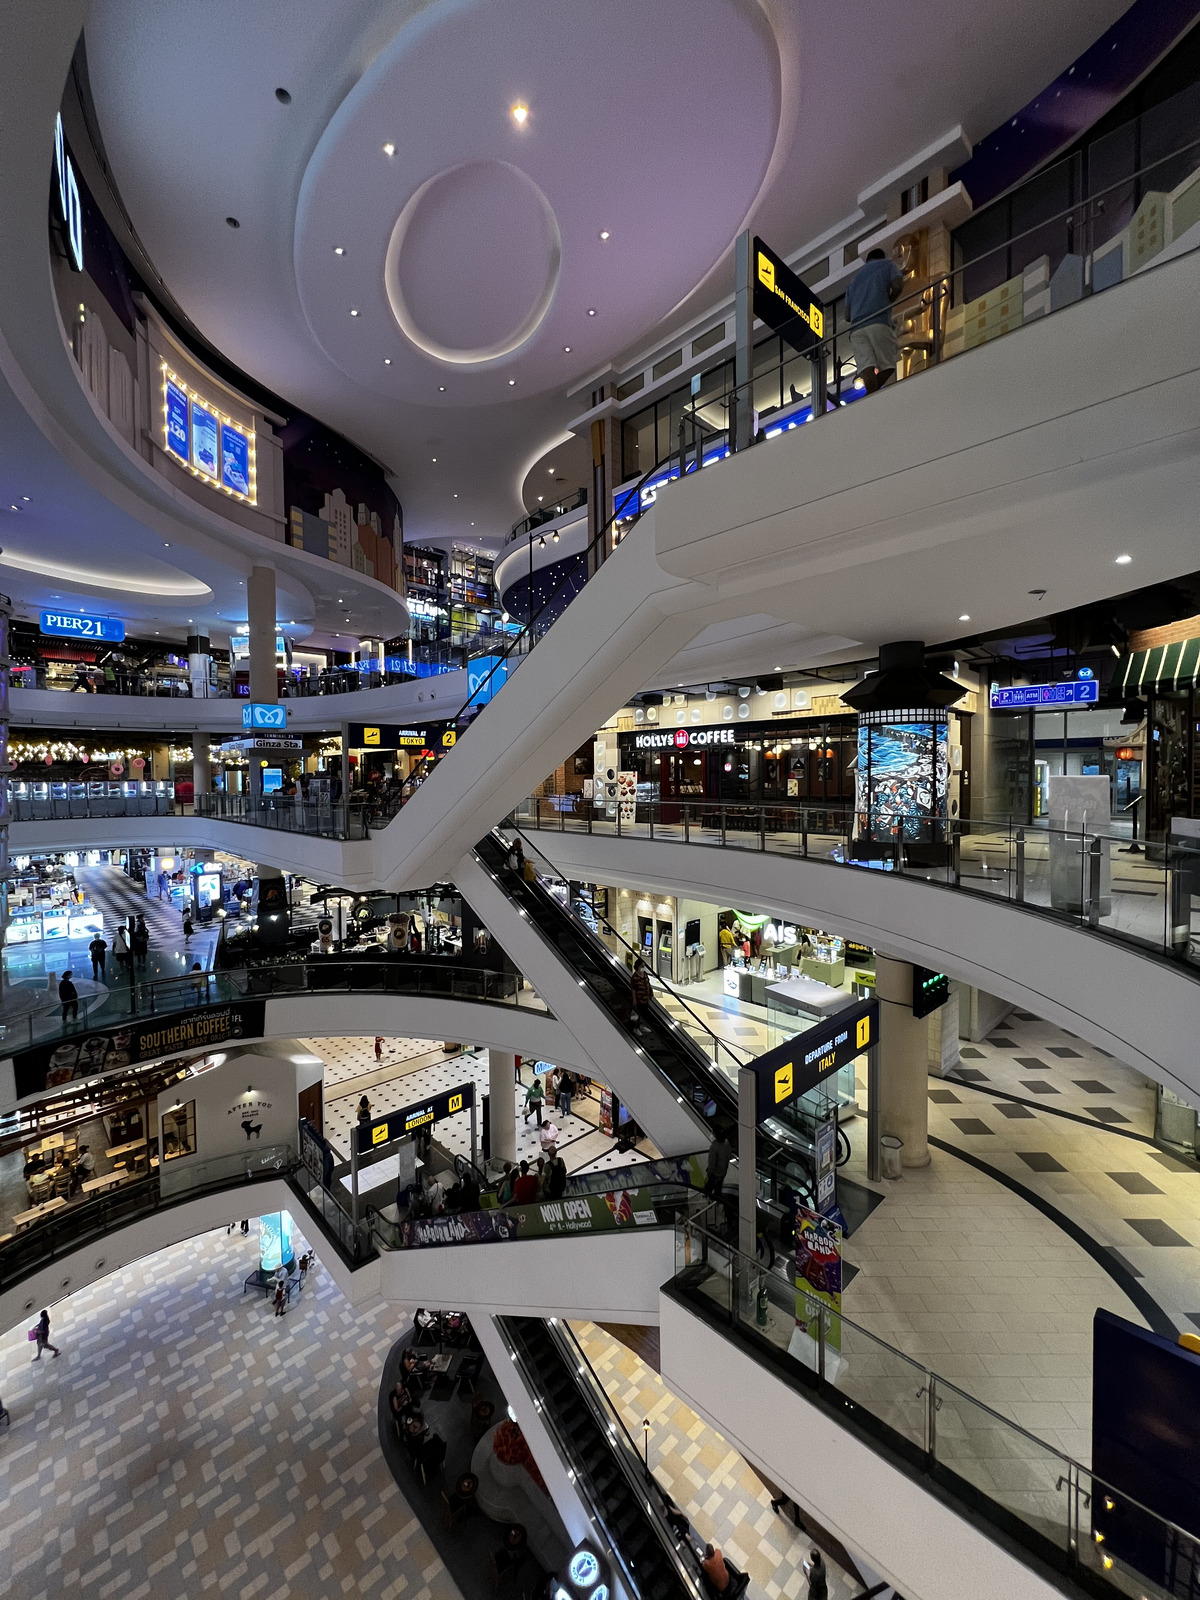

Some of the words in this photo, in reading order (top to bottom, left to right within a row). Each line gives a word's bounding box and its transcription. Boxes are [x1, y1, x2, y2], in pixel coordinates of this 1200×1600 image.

[774, 284, 785, 300] SAN
[785, 295, 810, 324] FRANCISCO
[814, 312, 820, 329] 3
[169, 421, 186, 442] 120
[45, 614, 104, 637] PIER21
[1080, 685, 1090, 698] 2
[255, 740, 282, 749] Ginza
[283, 740, 302, 749] Sta.
[402, 737, 423, 745] TOKYO
[446, 733, 453, 744] 2
[635, 734, 674, 748] HOLLYS
[689, 729, 735, 744] COFFEE
[764, 923, 797, 944] AIS
[140, 1023, 194, 1051] SOUTHERN
[196, 1015, 231, 1037] COFFEE
[860, 1022, 865, 1041] 1
[804, 1039, 834, 1065] DEPARTURE
[834, 1030, 848, 1047] FROM
[818, 1051, 836, 1073] ITALY
[227, 1101, 254, 1116] AFTER
[257, 1101, 273, 1109] YOU
[451, 1096, 460, 1109] M
[405, 1109, 426, 1122] ARRIVAL
[427, 1105, 434, 1113] AT
[407, 1112, 432, 1128] LONDON
[540, 1202, 564, 1223] NOW
[564, 1199, 593, 1220] OPEN
[565, 1220, 592, 1231] Hollywood
[805, 1230, 835, 1250] HARBOR
